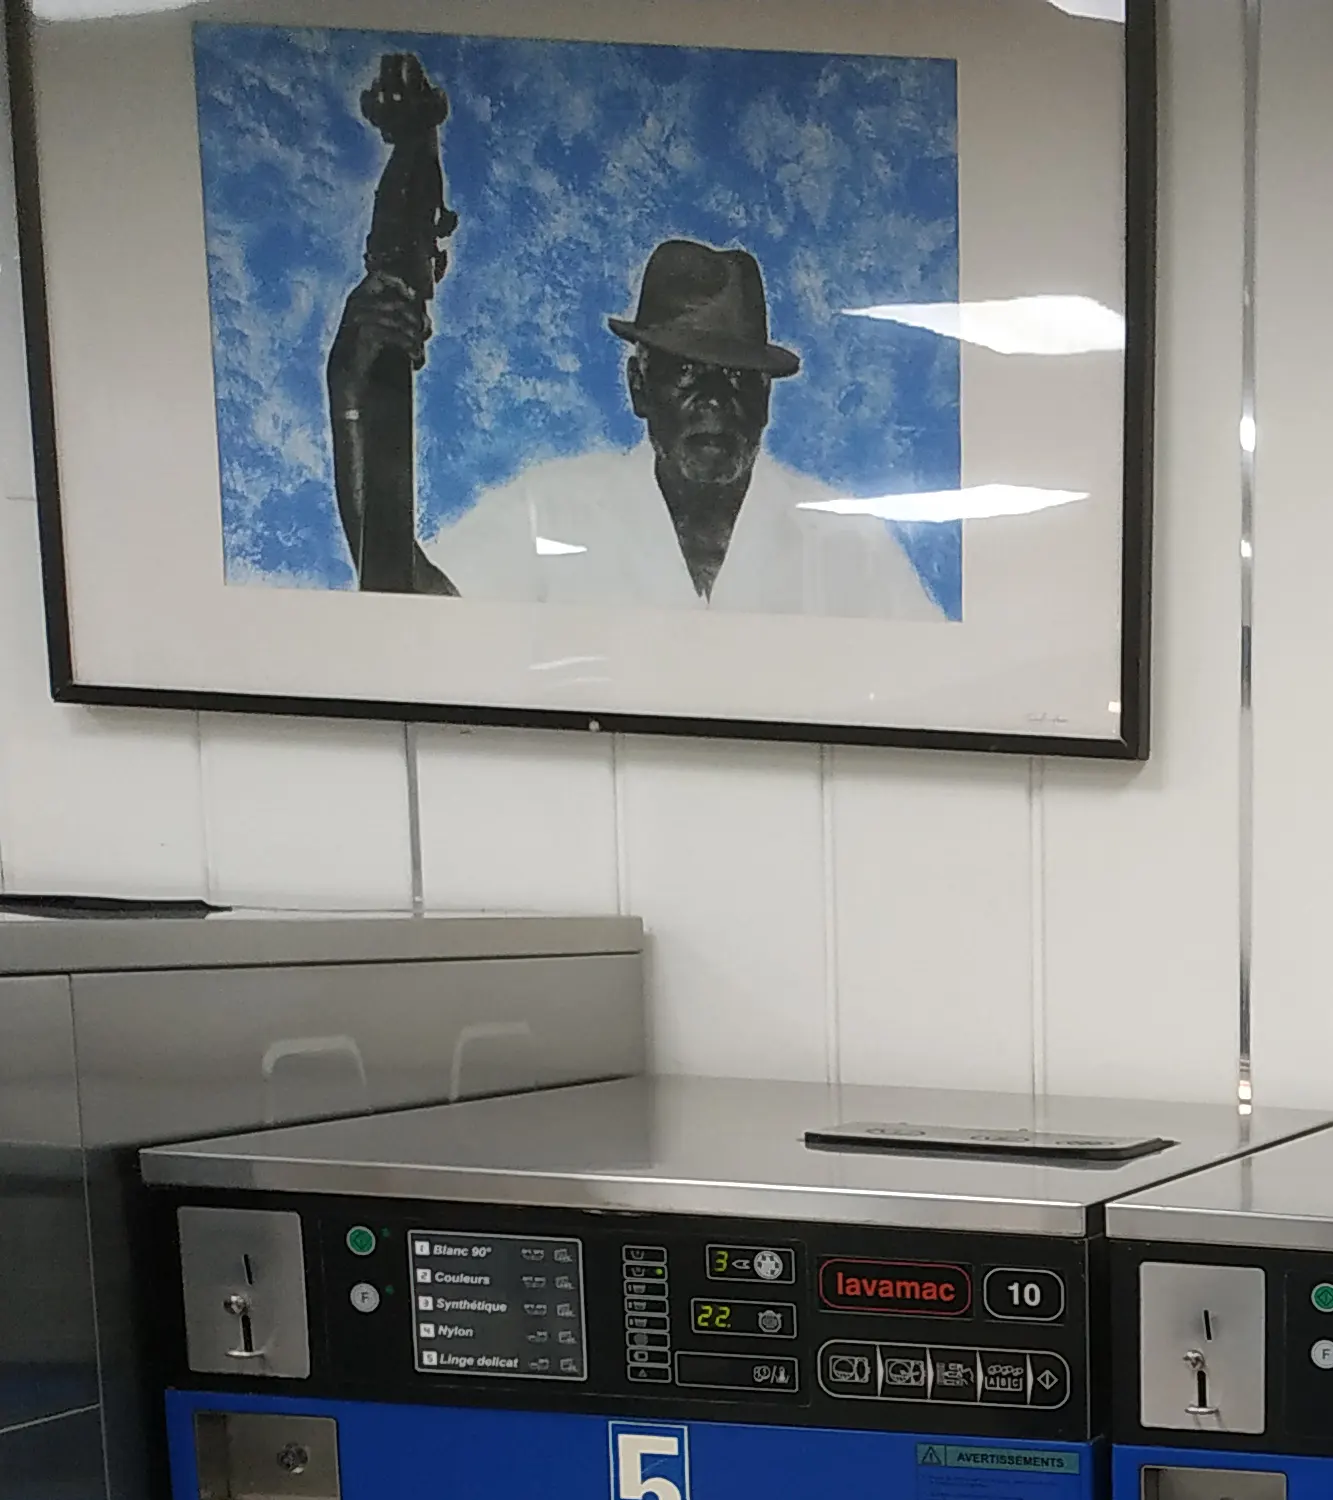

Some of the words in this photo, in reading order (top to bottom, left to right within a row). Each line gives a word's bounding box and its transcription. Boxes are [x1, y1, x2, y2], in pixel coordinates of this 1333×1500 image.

[433, 1244, 469, 1257] Blanc
[714, 1250, 729, 1272] 3
[434, 1272, 490, 1285] Couleurs
[836, 1271, 956, 1301] lavamac
[361, 1292, 369, 1303] F
[1008, 1282, 1041, 1307] 10
[436, 1298, 508, 1314] Synthétique
[437, 1325, 474, 1338] Nylon
[439, 1353, 474, 1368] Linge
[1322, 1348, 1331, 1360] F
[957, 1452, 1065, 1468] AVERTISSEMENTS
